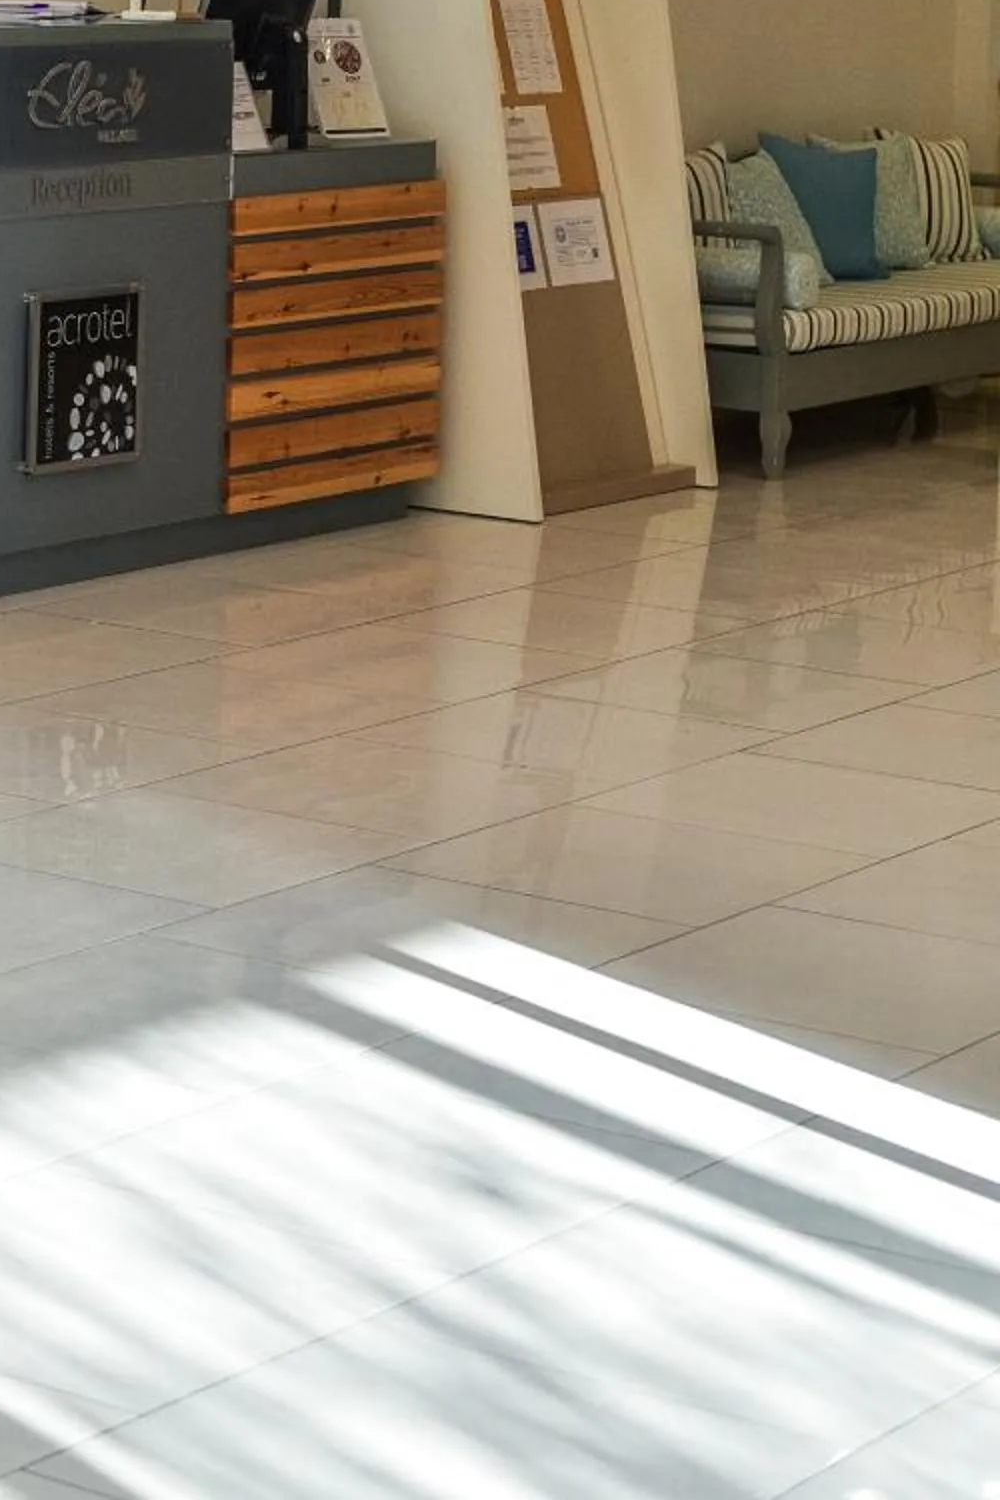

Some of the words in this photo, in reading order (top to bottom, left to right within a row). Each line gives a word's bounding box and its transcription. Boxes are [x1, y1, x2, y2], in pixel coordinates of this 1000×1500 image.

[31, 170, 133, 208] Reception
[47, 295, 132, 347] acrotel
[47, 351, 57, 400] resorts
